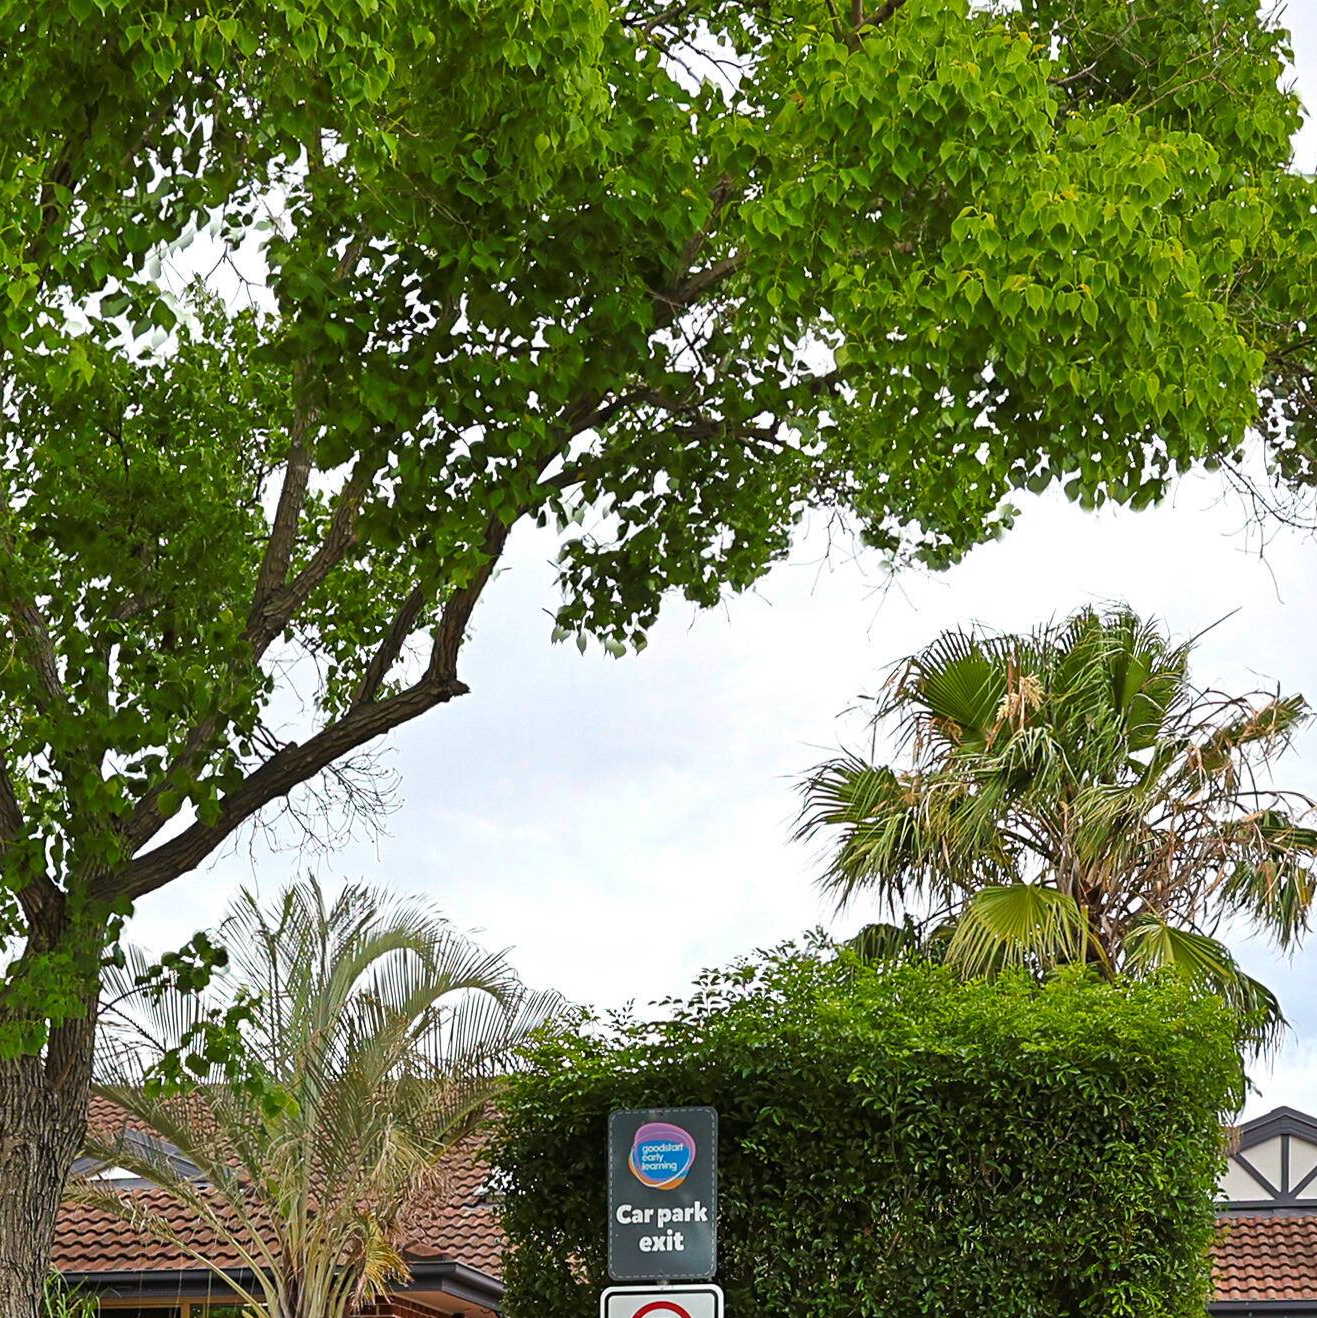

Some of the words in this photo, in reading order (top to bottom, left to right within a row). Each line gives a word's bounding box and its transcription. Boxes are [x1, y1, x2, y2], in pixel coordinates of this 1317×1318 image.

[642, 1142, 683, 1154] goodstart
[642, 1153, 664, 1162] early
[642, 1161, 677, 1171] learning
[616, 1204, 654, 1223] Car
[657, 1201, 708, 1227] park
[639, 1229, 684, 1252] exit
